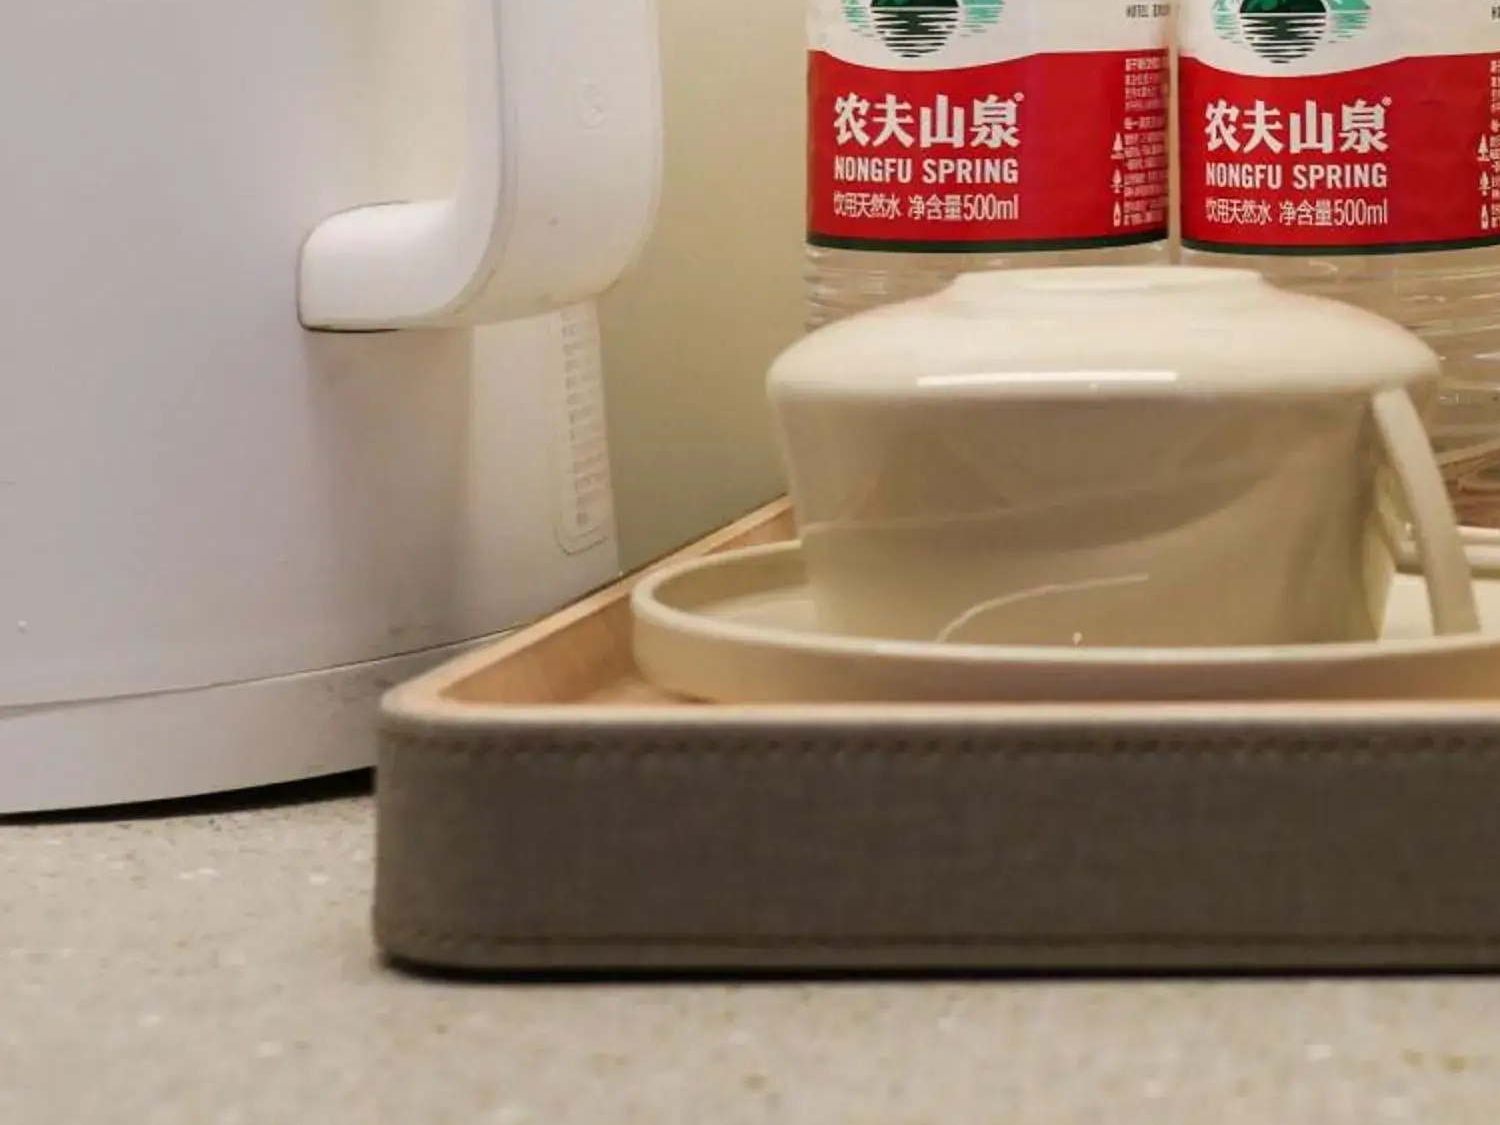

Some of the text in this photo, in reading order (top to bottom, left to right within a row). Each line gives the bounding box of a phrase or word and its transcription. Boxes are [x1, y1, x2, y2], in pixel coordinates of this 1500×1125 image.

[834, 92, 1021, 149] 农夫山泉
[1205, 98, 1389, 154] 农夫山泉
[834, 155, 1019, 184] NONGFU SPRING
[1206, 162, 1387, 190] NONGFU SPRING
[834, 191, 1019, 221] 饮用天然水 净含量500ml
[1205, 197, 1388, 226] 饮用天然水 净含量500ml
